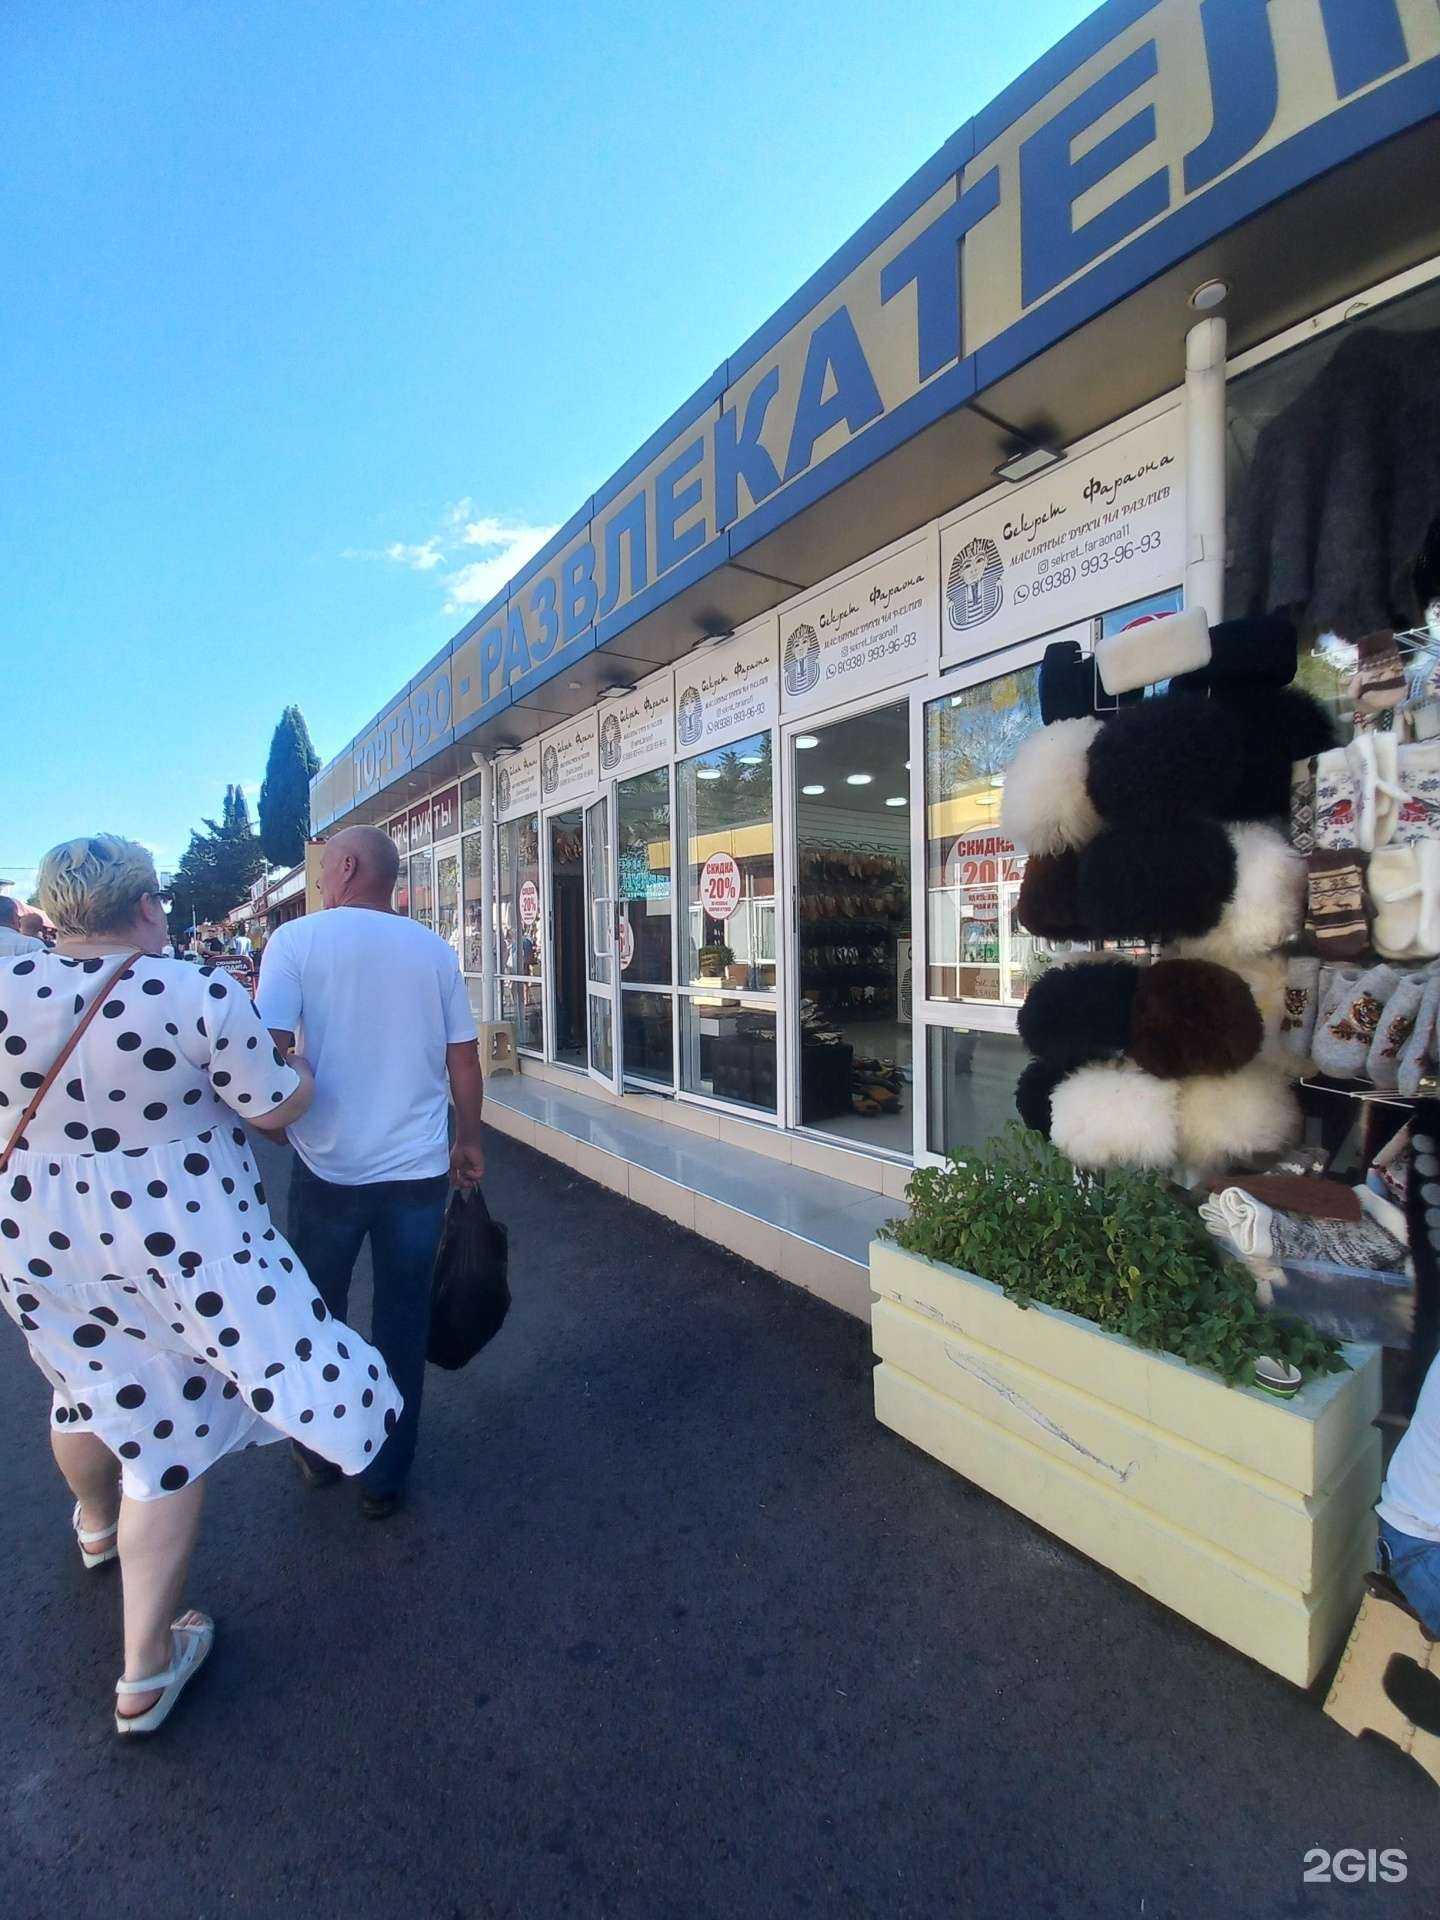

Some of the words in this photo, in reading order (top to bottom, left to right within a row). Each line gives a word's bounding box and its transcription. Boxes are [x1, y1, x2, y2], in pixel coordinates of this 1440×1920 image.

[1003, 503, 1067, 542] Секрет
[1083, 454, 1175, 505] Фараона
[1009, 533, 1067, 567] МАСЛЯНЫЕ
[1067, 517, 1101, 542] ДУХИ
[1102, 509, 1119, 525] НА
[1121, 486, 1171, 517] РАЗЛИВ
[1032, 566, 1077, 598] 8(938)
[1080, 530, 1162, 577] 993-96-93
[868, 632, 917, 662] 993-96-93
[391, 799, 452, 845] ПРОДУКТЫ
[957, 837, 1015, 856] СКИДКА
[706, 861, 734, 875] СКИДКА
[704, 877, 736, 898] -20%
